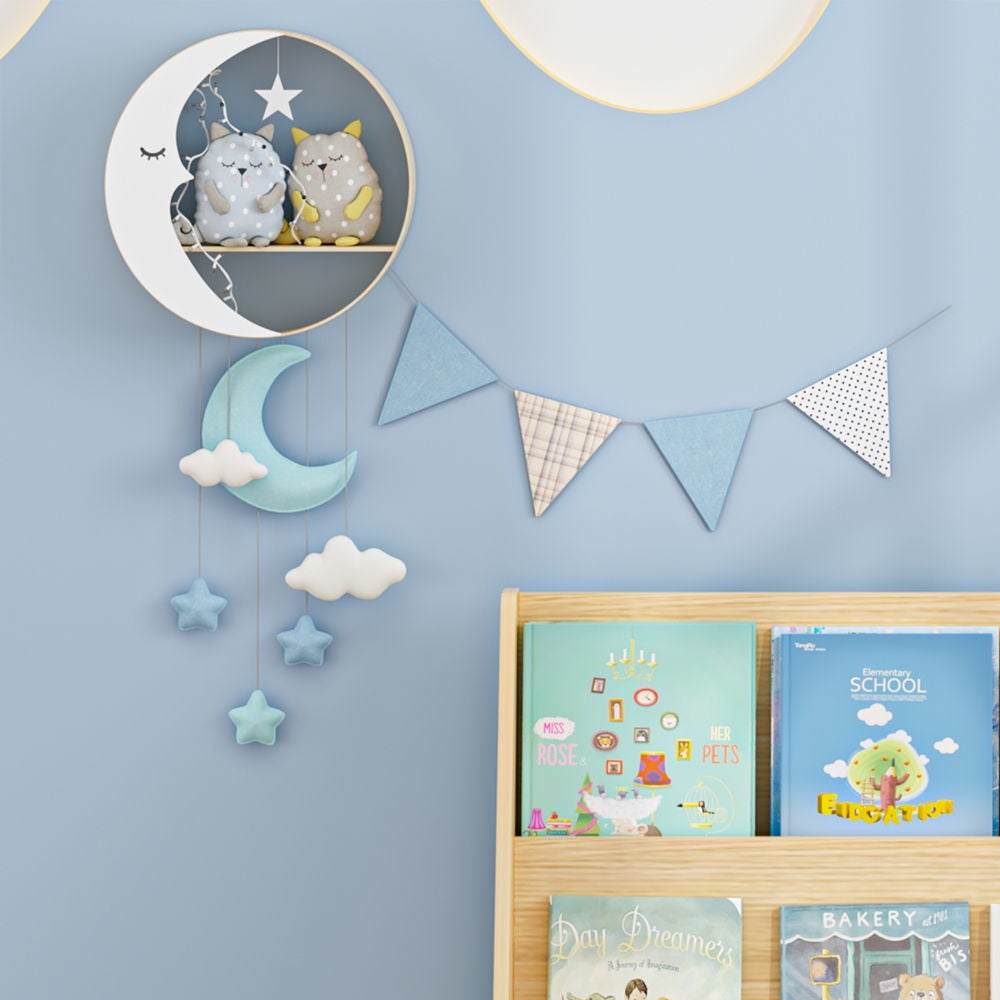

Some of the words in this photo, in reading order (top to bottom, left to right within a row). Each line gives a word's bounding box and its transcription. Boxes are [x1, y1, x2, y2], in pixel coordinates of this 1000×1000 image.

[862, 667, 911, 678] Elementary
[850, 676, 927, 694] SCHOOL
[543, 722, 565, 735] MISS
[710, 726, 731, 741] HER
[537, 743, 579, 766] ROSE
[702, 744, 740, 765] PETS
[822, 910, 917, 929] BAKERY
[550, 914, 607, 966] Day
[617, 904, 734, 969] Dreamers
